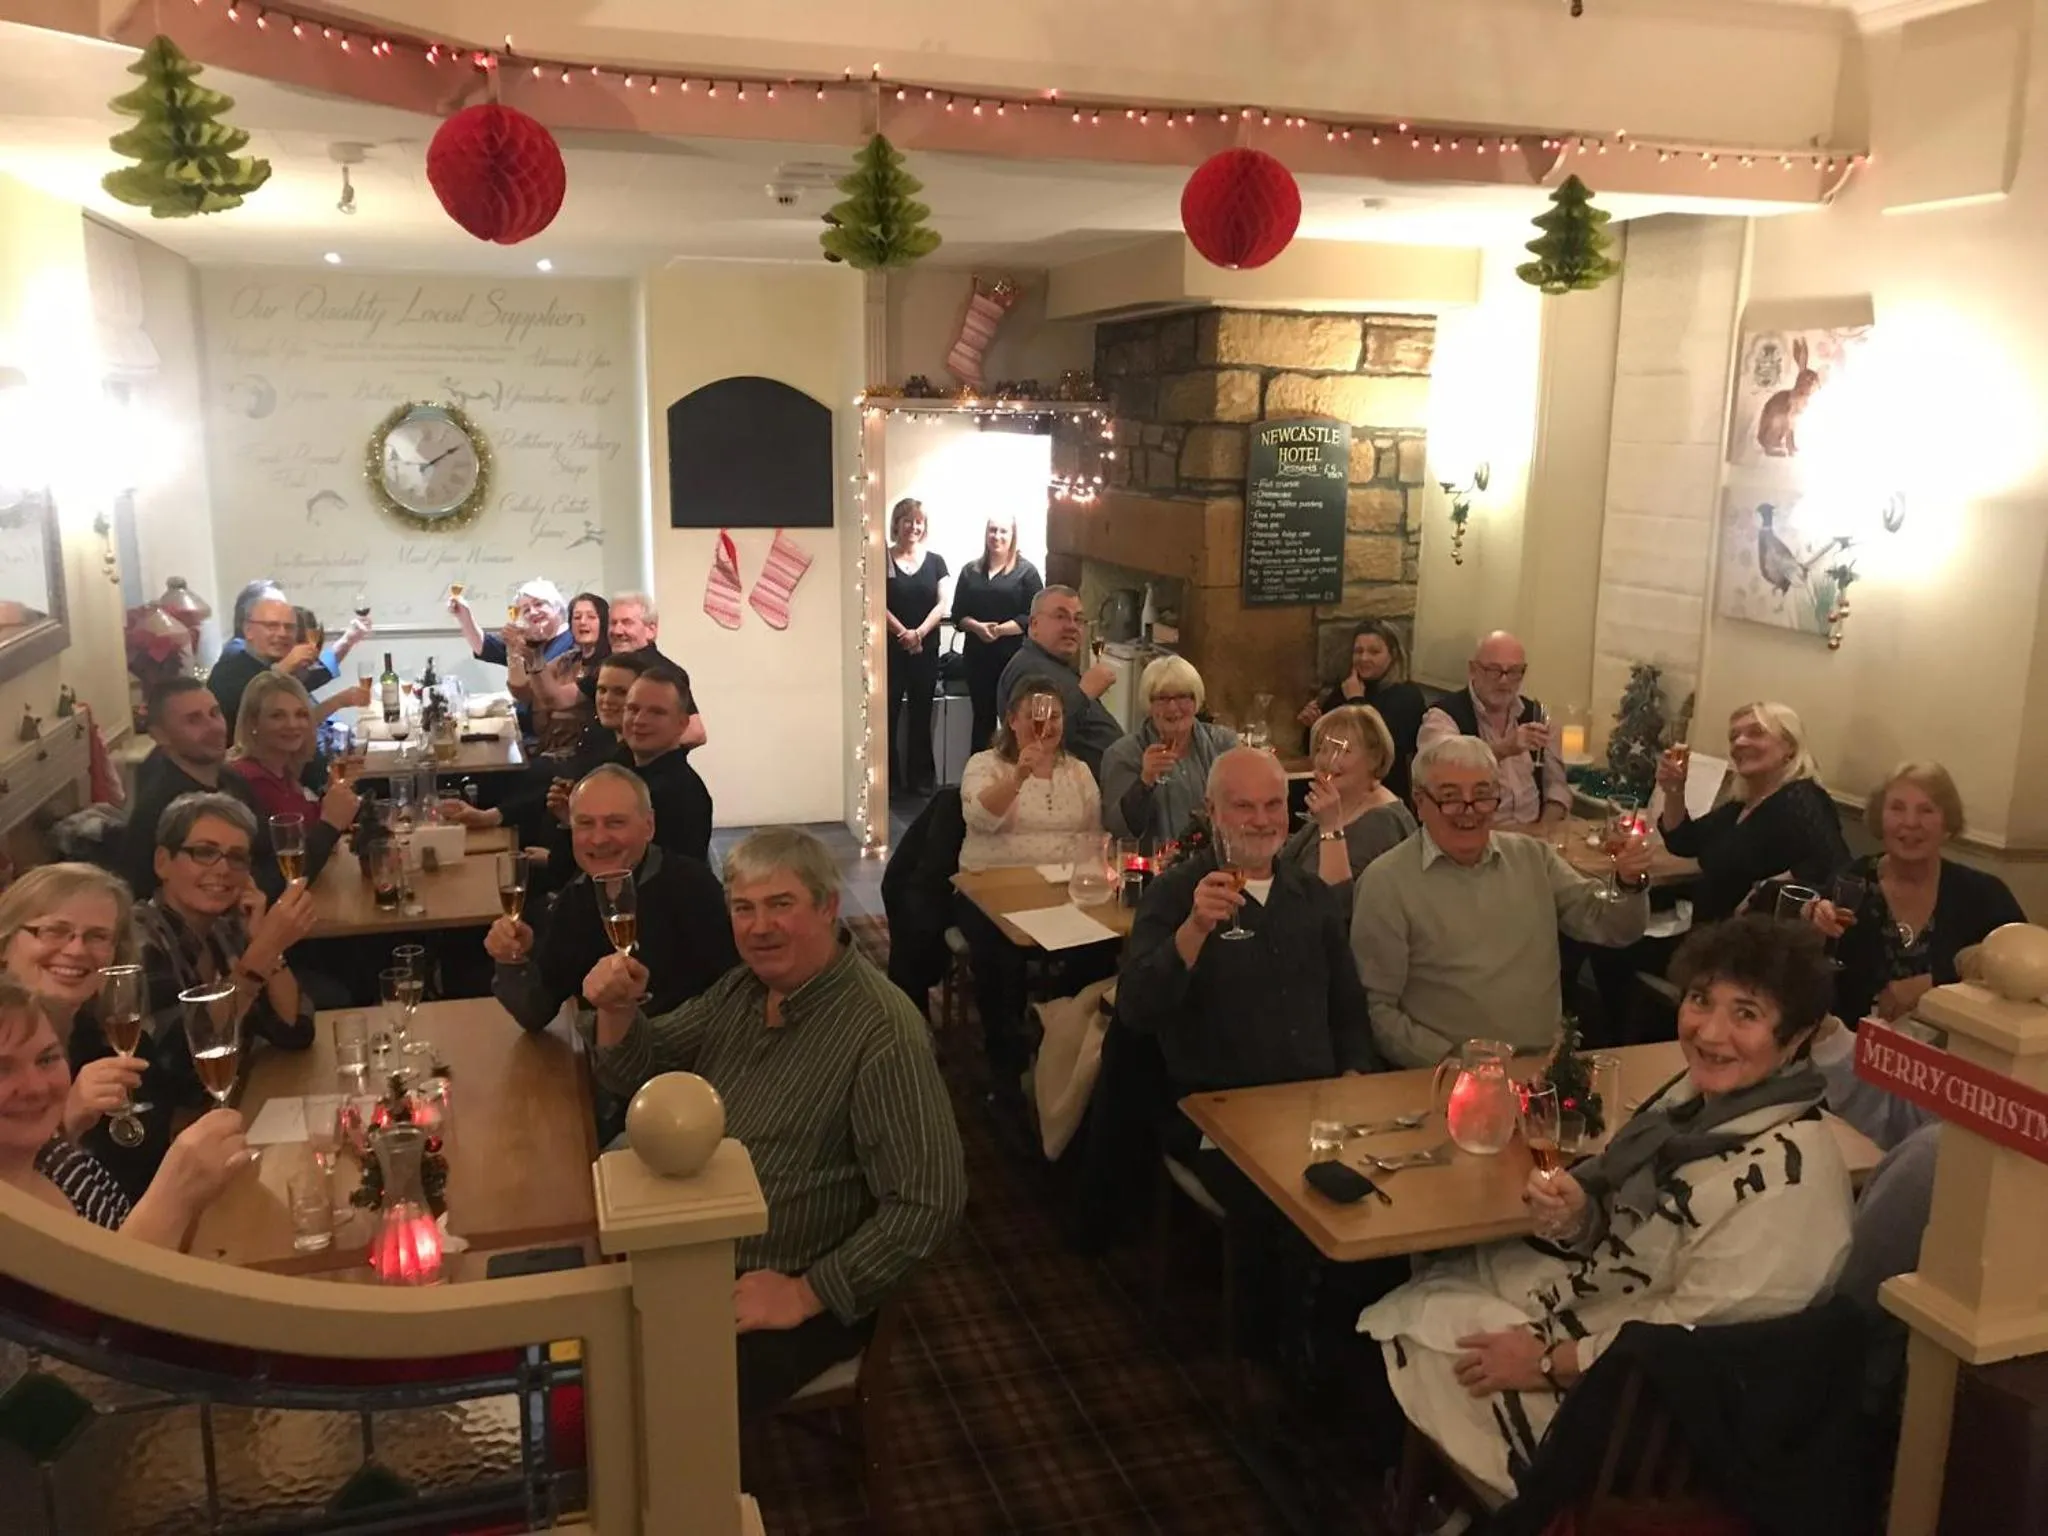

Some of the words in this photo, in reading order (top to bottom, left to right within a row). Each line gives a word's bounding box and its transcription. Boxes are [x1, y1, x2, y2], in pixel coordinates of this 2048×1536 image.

[229, 283, 284, 320] Our
[295, 283, 401, 340] Quality
[396, 286, 475, 326] Local
[475, 288, 586, 343] Suppliers
[1261, 426, 1341, 446] NEWCASTLE
[1279, 447, 1321, 462] HOTEL
[1861, 1037, 1945, 1096] MERRY
